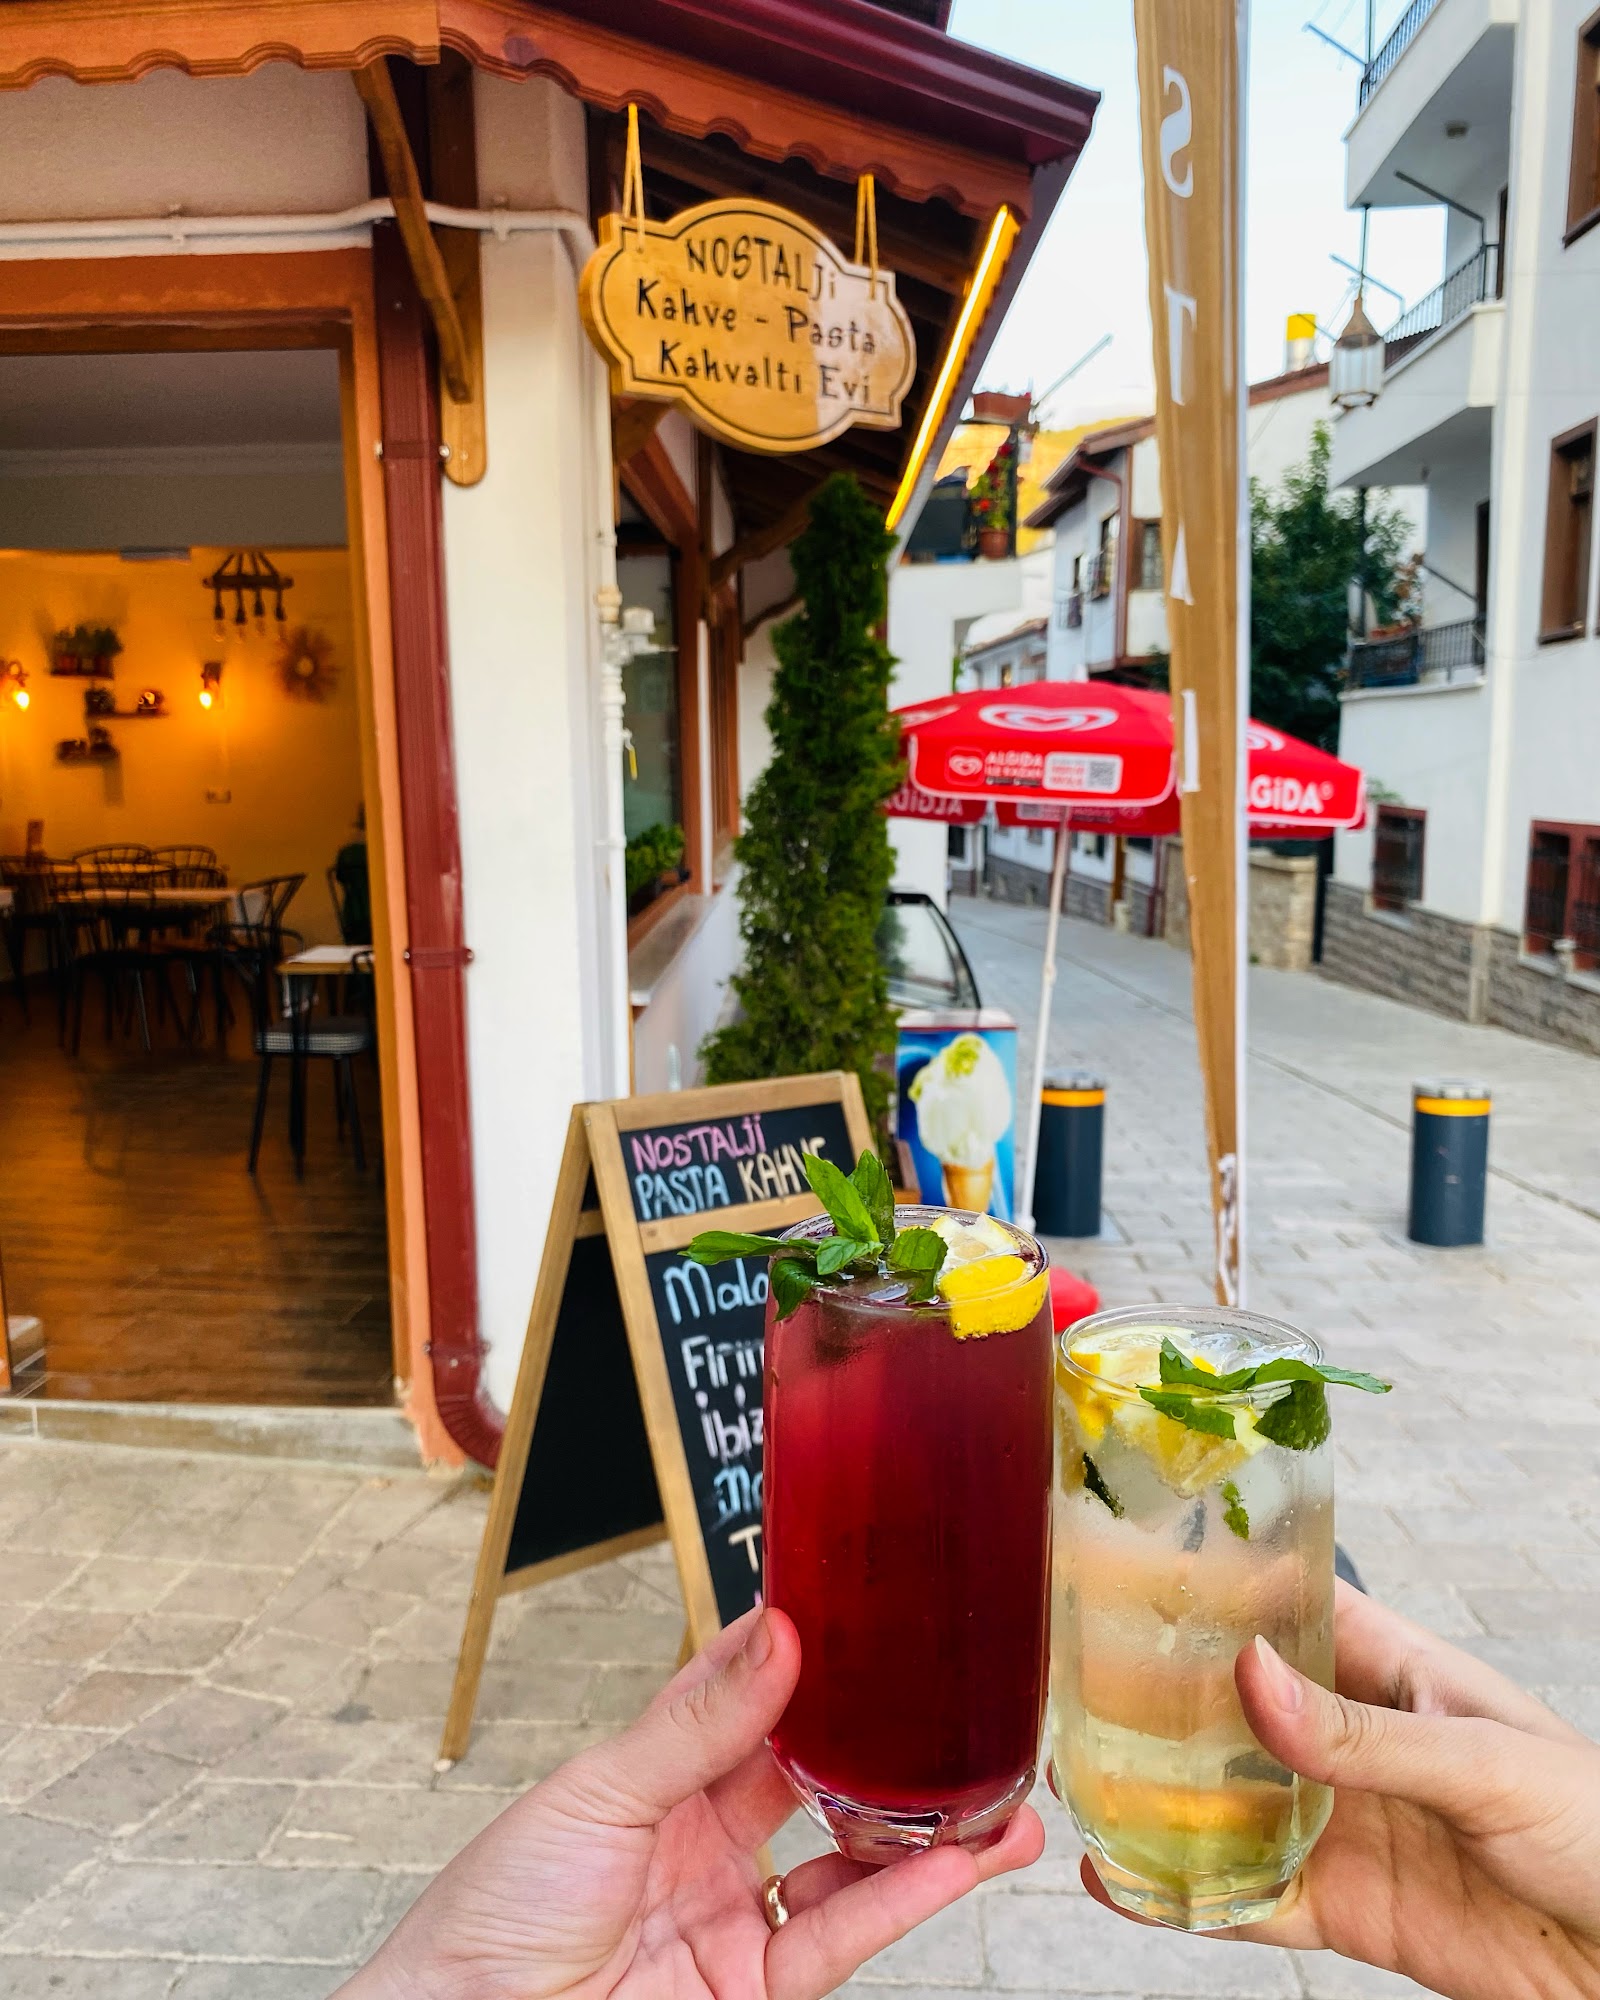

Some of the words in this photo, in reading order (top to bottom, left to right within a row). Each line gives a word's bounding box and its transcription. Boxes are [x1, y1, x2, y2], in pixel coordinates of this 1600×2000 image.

[637, 277, 737, 332] Kahve
[784, 305, 876, 354] Pasta
[820, 364, 872, 405] Evi
[635, 1163, 731, 1221] PASTA
